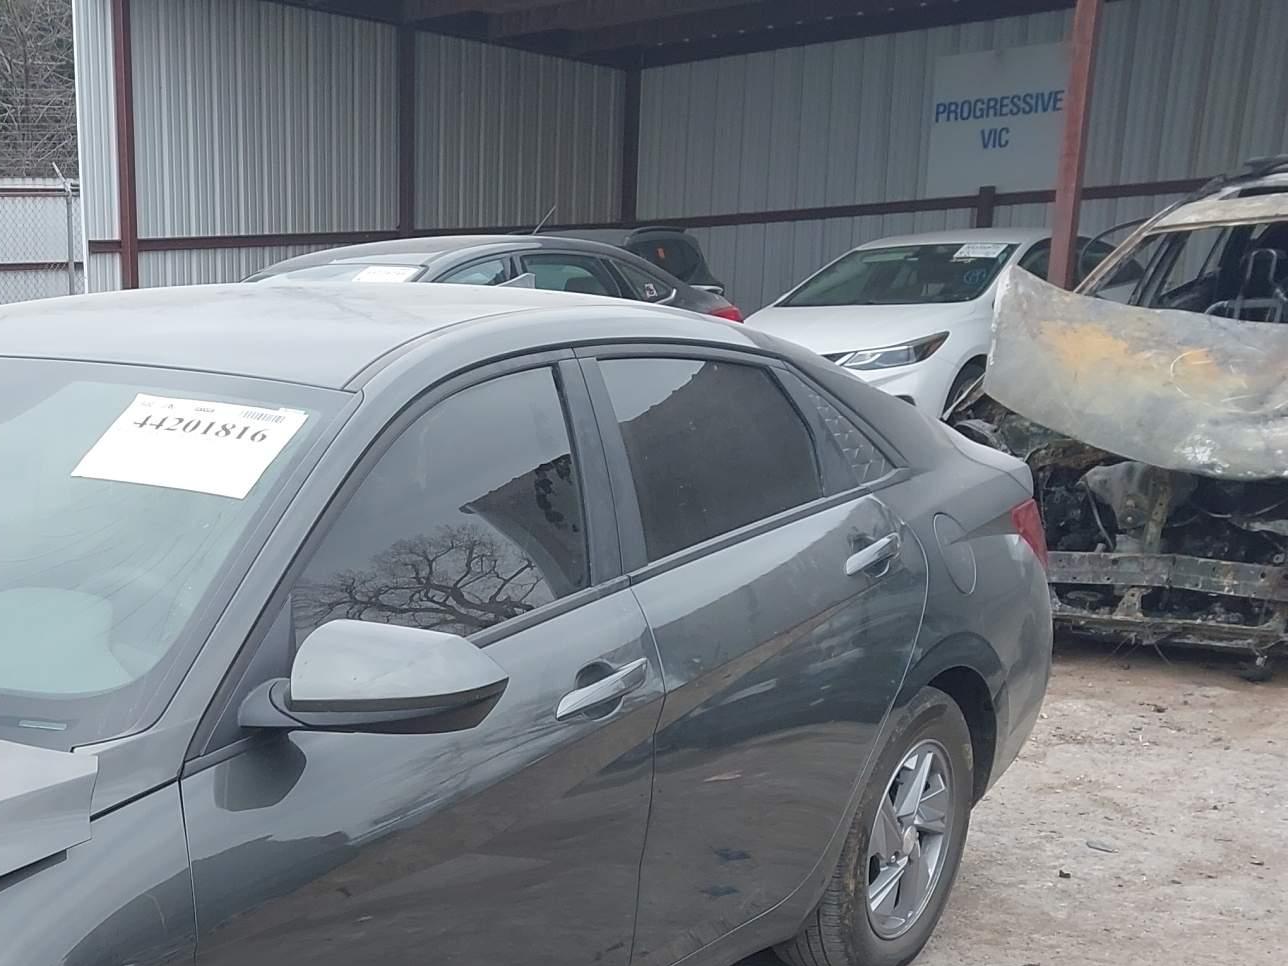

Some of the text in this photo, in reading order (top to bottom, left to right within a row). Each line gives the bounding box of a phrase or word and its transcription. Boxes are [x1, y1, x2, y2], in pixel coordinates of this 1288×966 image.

[935, 90, 1065, 123] PROGRESSIVE
[980, 127, 1010, 149] VIC
[133, 414, 268, 443] 44201816
